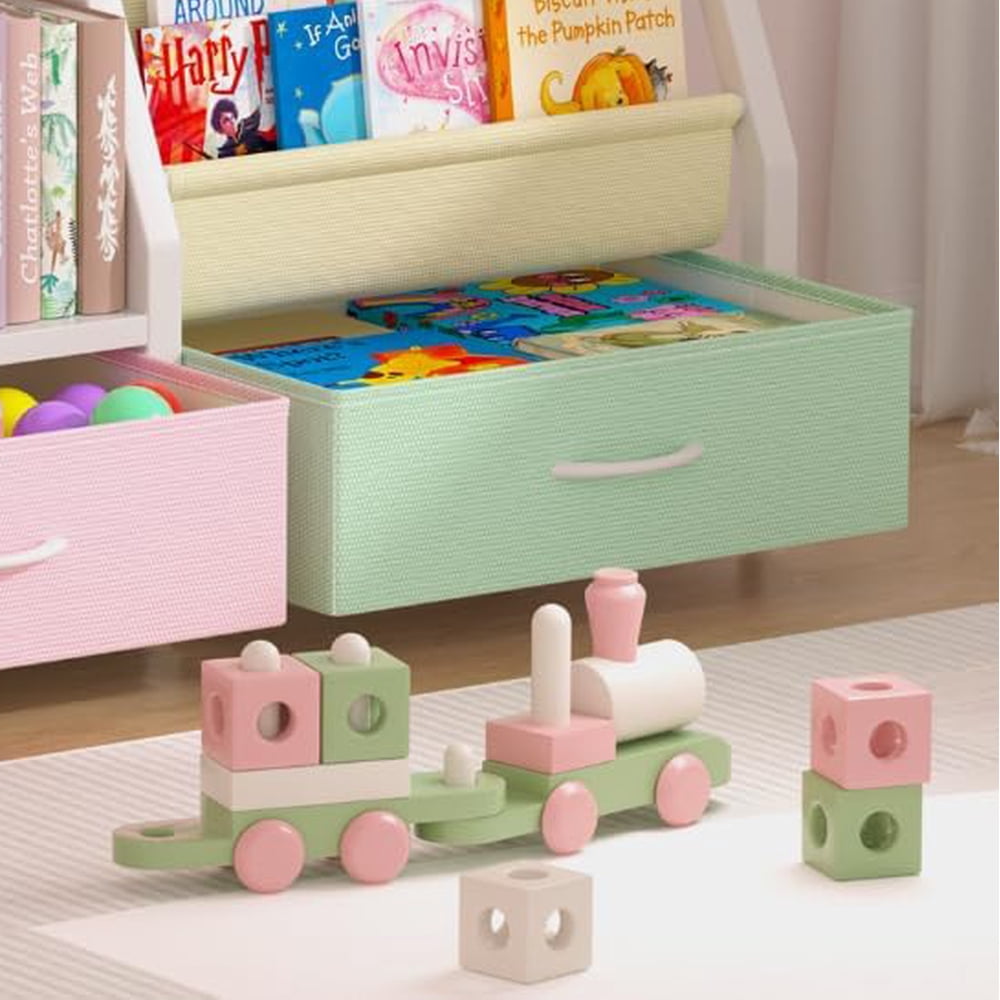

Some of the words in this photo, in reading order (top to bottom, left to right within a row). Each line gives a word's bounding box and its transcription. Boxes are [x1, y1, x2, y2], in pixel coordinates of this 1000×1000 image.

[304, 23, 322, 47] If
[517, 24, 548, 48] the
[552, 14, 623, 45] Pumpkin
[625, 5, 676, 34] Patch
[19, 52, 38, 116] Web
[157, 34, 248, 109] Harry
